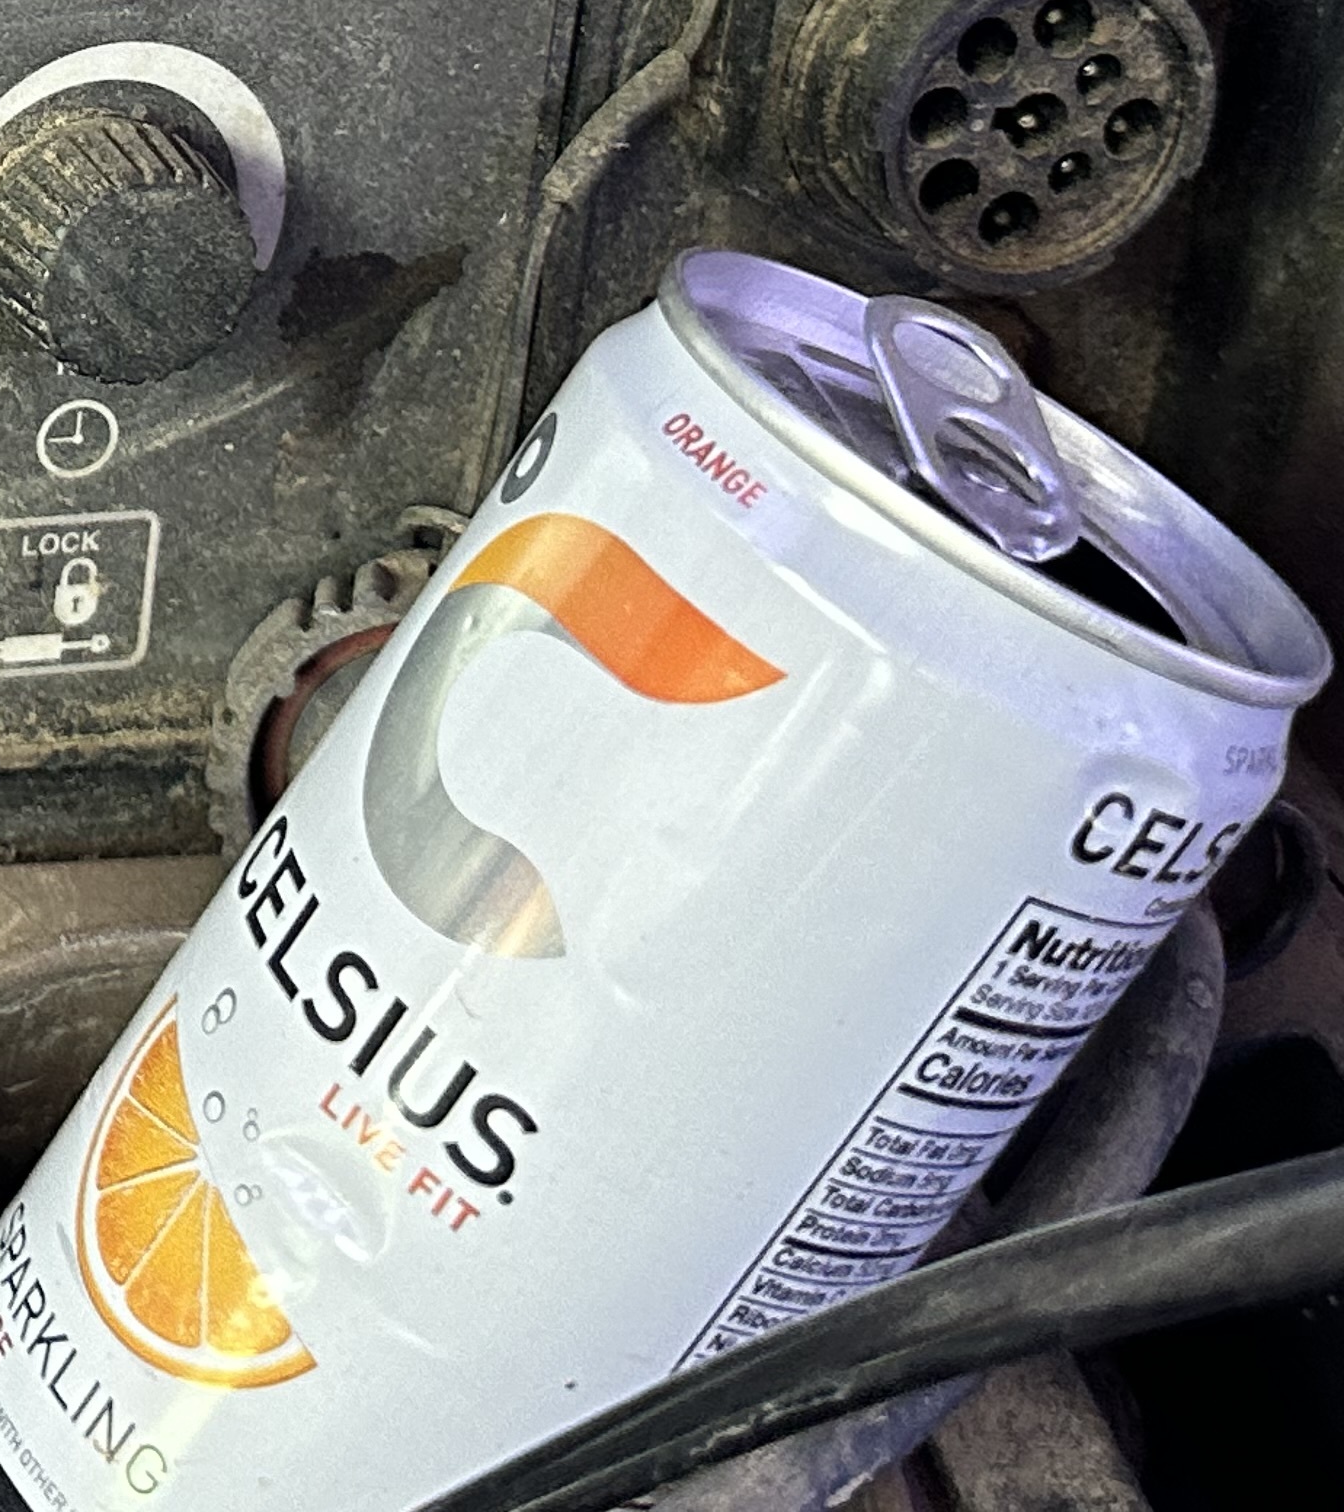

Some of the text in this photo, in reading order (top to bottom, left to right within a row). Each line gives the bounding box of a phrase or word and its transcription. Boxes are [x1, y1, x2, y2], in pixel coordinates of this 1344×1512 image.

[661, 412, 768, 509] ORANGE
[21, 530, 100, 558] LOCK
[916, 1052, 1034, 1096] Calories
[318, 1082, 481, 1233] LIVE FIT
[865, 1126, 920, 1155] Total
[820, 1185, 874, 1213] Total
[0, 1201, 169, 1494] SPARKLING
